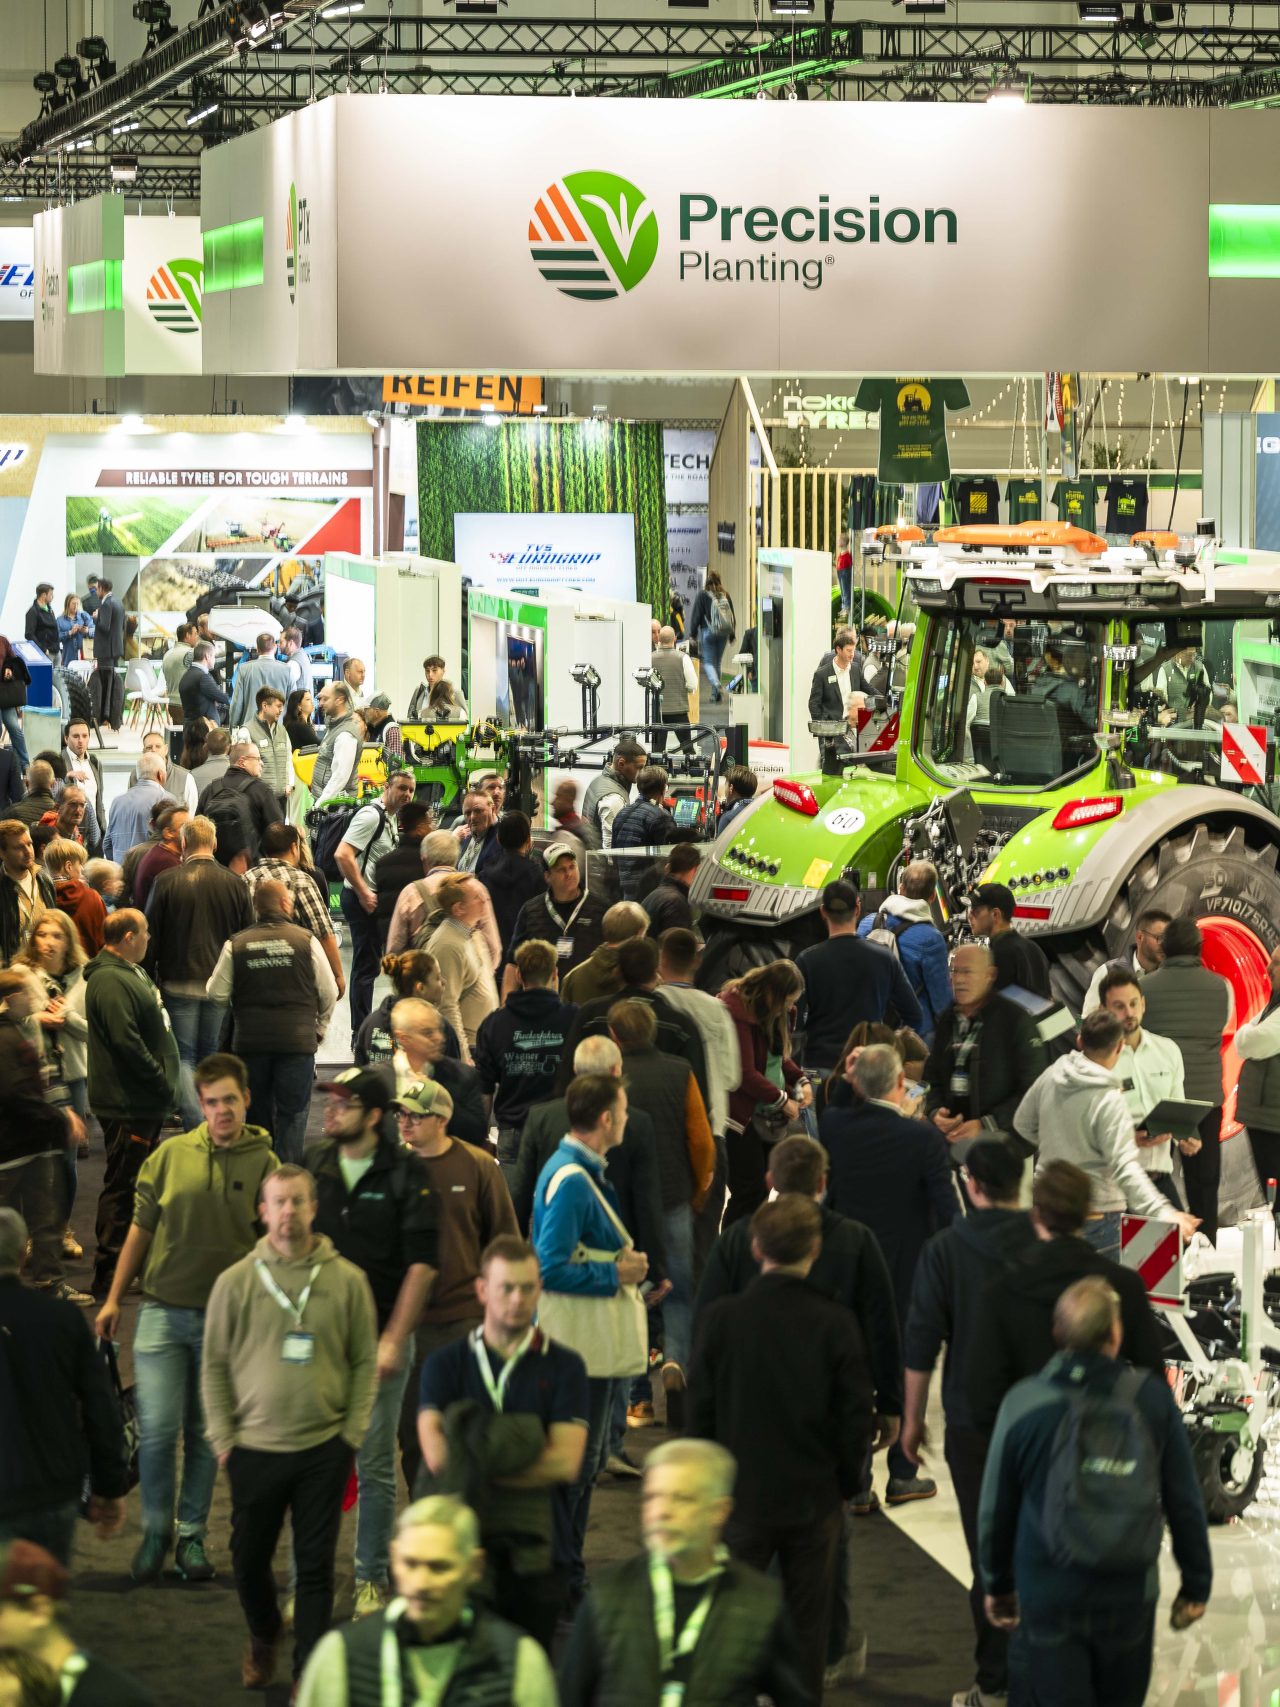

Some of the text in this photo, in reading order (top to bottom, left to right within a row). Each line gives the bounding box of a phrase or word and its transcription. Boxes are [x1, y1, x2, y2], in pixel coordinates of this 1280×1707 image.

[678, 192, 959, 245] Precision
[392, 375, 522, 401] REIFEN
[783, 410, 880, 430] TYRES
[665, 453, 711, 470] ECH
[125, 471, 349, 485] RELIABLE TYRES FOR TOUGH TERRAINS
[526, 543, 553, 552] TVS
[750, 764, 784, 773] recision
[246, 956, 293, 969] SERVICE
